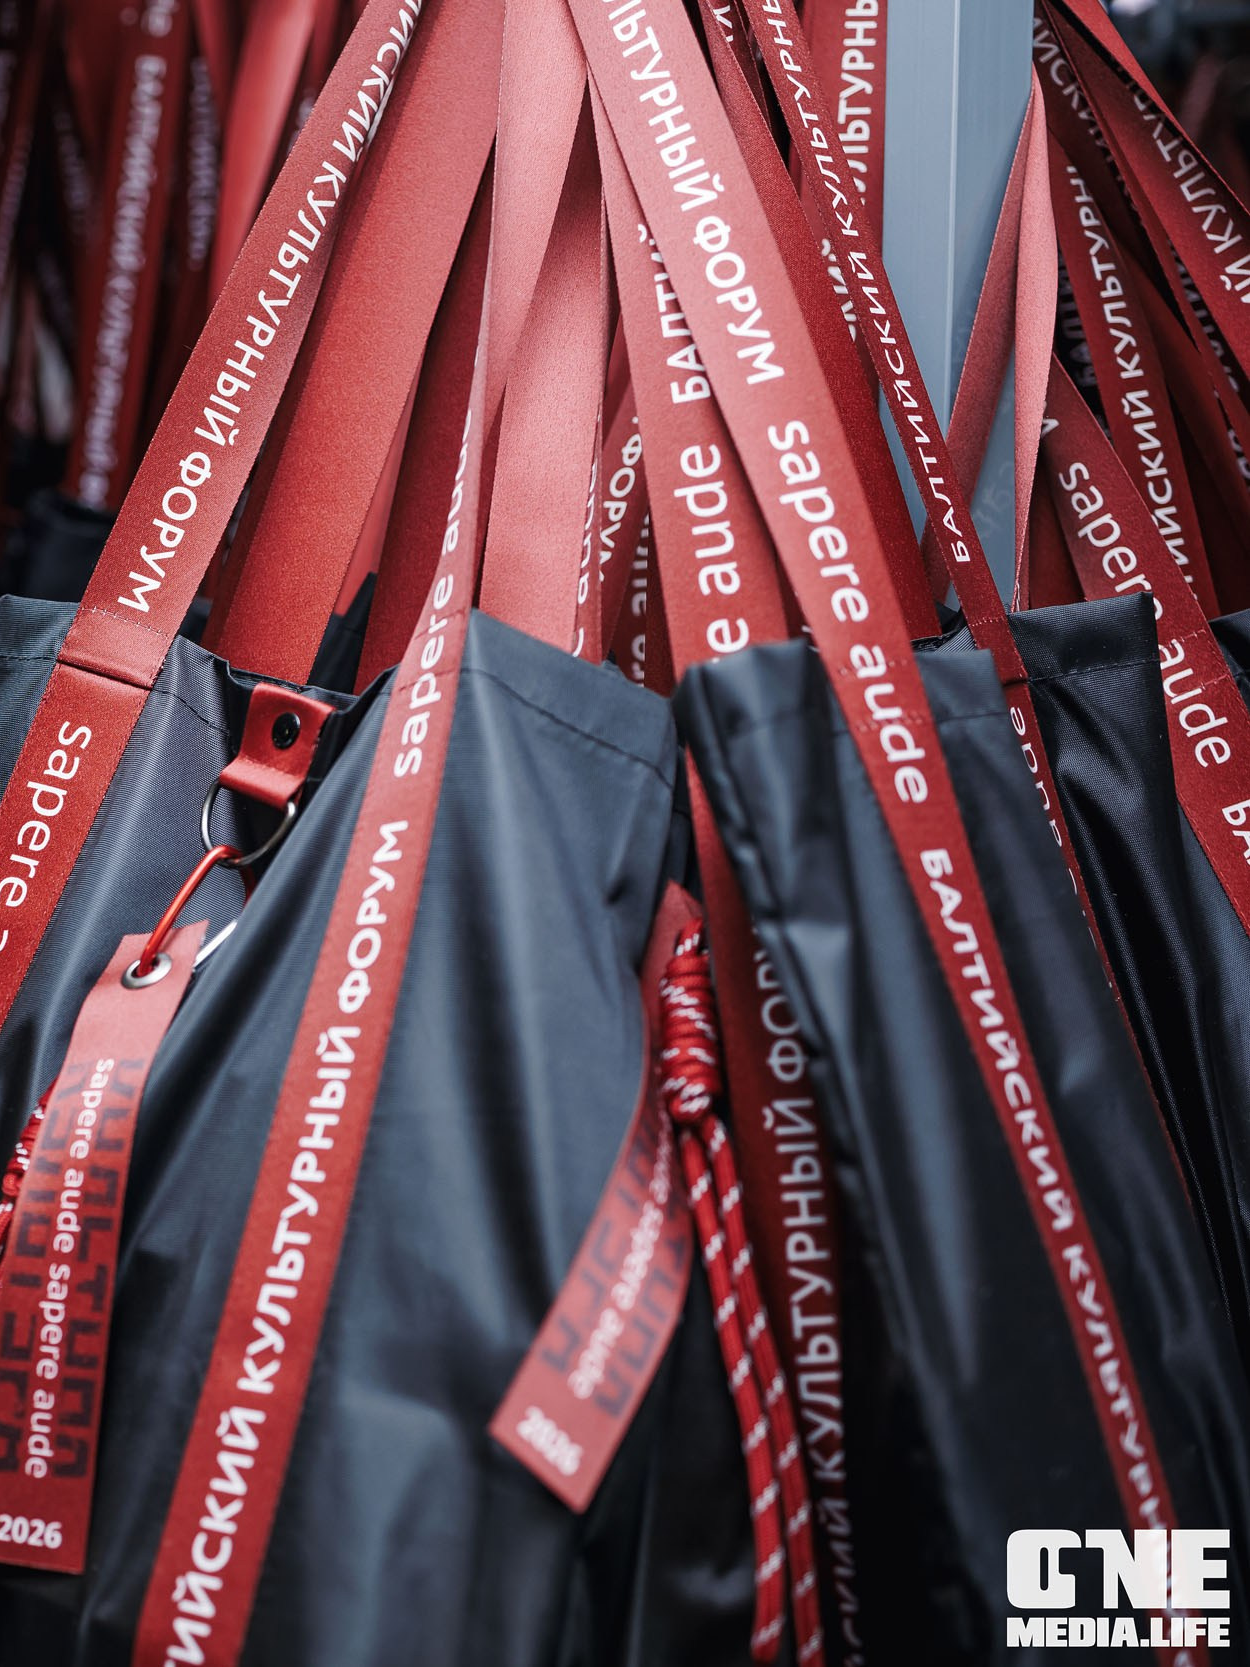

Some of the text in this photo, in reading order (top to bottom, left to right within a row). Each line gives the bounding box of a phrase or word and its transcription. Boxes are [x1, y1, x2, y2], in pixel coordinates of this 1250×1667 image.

[194, 161, 346, 446] КУЛЬТУРНЫЙ
[848, 252, 970, 562] БАЛТИЙСКИЙ
[1067, 167, 1143, 378] КУЛЬТУРН
[118, 452, 212, 612] ФОРУМ
[674, 445, 740, 595] aude
[693, 216, 784, 384] ФОРУМ
[768, 421, 868, 621] sapere
[850, 645, 927, 802] aude
[920, 849, 1074, 1231] БАЛТИЙСКИЙ
[1158, 639, 1230, 767] aude
[25, 1058, 115, 1478] sapere aude sapere aude
[165, 1407, 265, 1667] ИЙСКИЙ
[237, 1026, 360, 1394] КУЛЬТУРНЫЙ
[337, 821, 408, 1013] ФОРУМ
[394, 574, 453, 777] sapere
[762, 1099, 846, 1480] КУЛЬТУРНЫЙ
